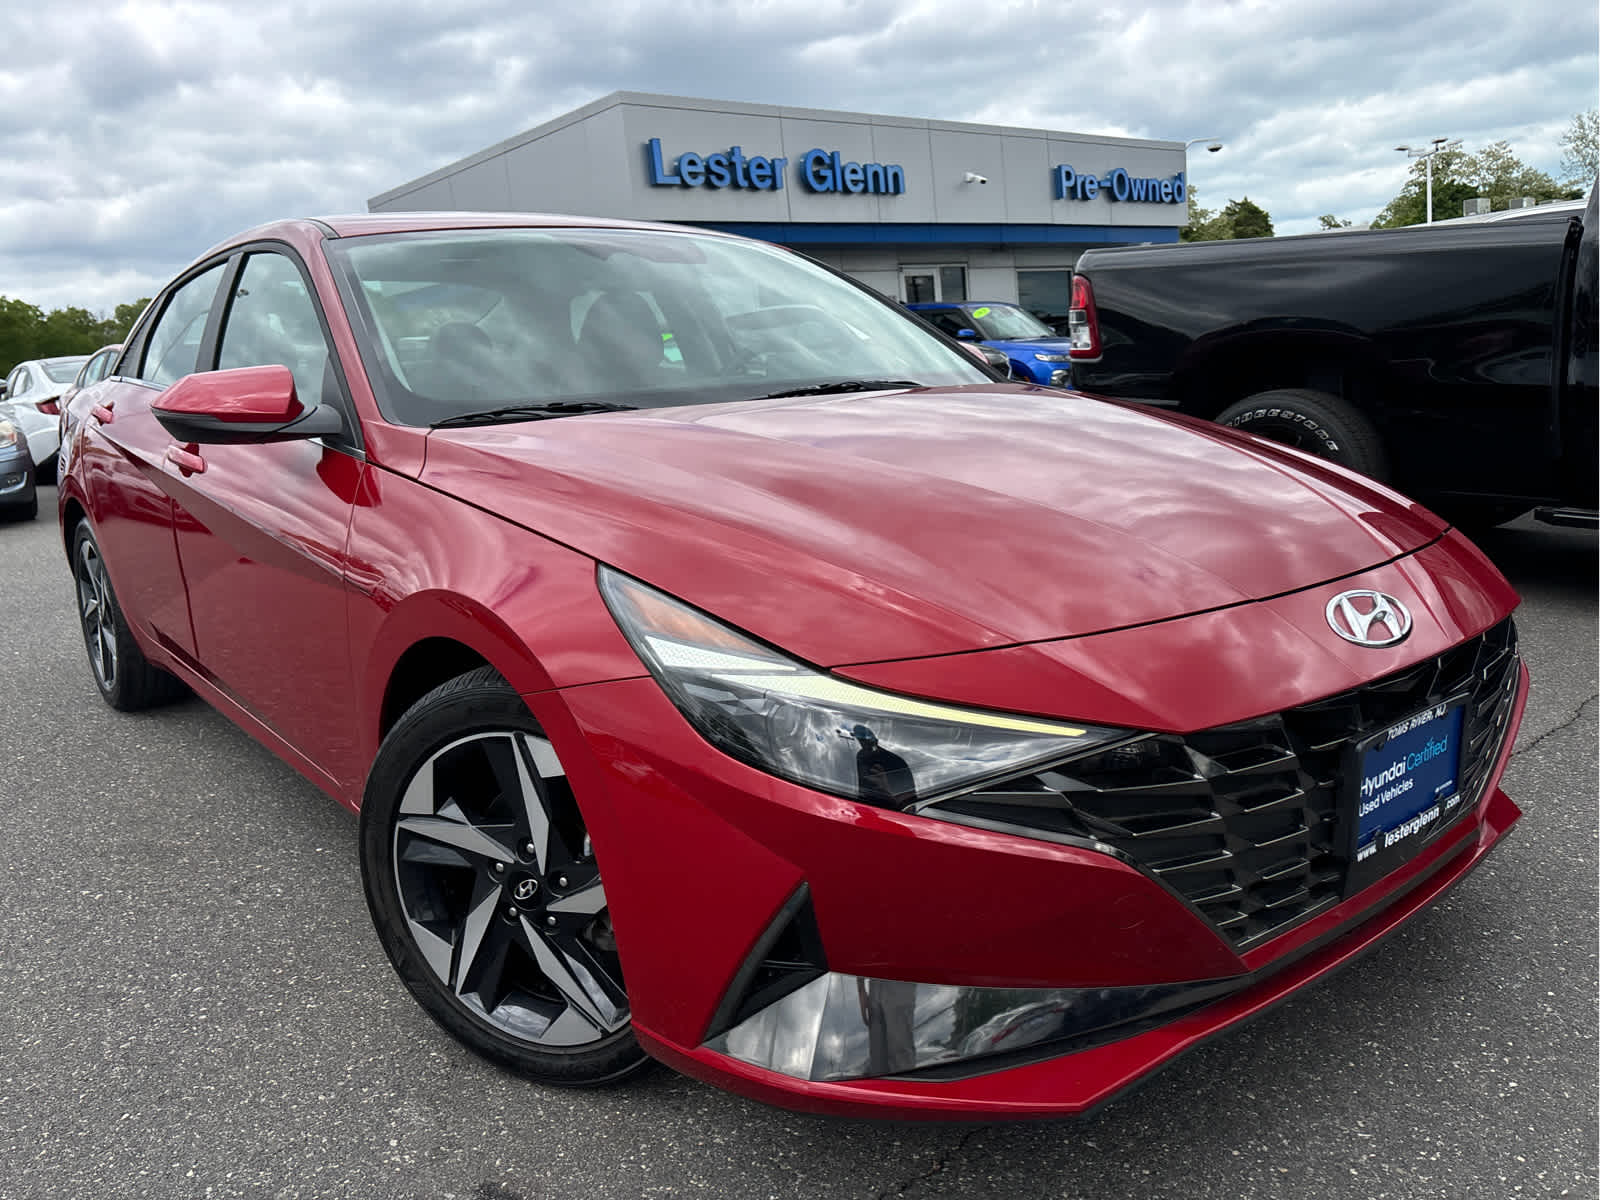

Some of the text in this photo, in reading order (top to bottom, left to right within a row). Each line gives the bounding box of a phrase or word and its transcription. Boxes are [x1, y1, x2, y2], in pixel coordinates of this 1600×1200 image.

[646, 137, 905, 196] Lester Glenn
[1054, 164, 1187, 206] Pre-Owned
[1387, 722, 1409, 740] TOMS
[1360, 735, 1448, 797] Hyundai Certified
[1359, 795, 1380, 817] Used
[1381, 778, 1413, 804] Vehicles
[1384, 807, 1439, 848] lesterglenn
